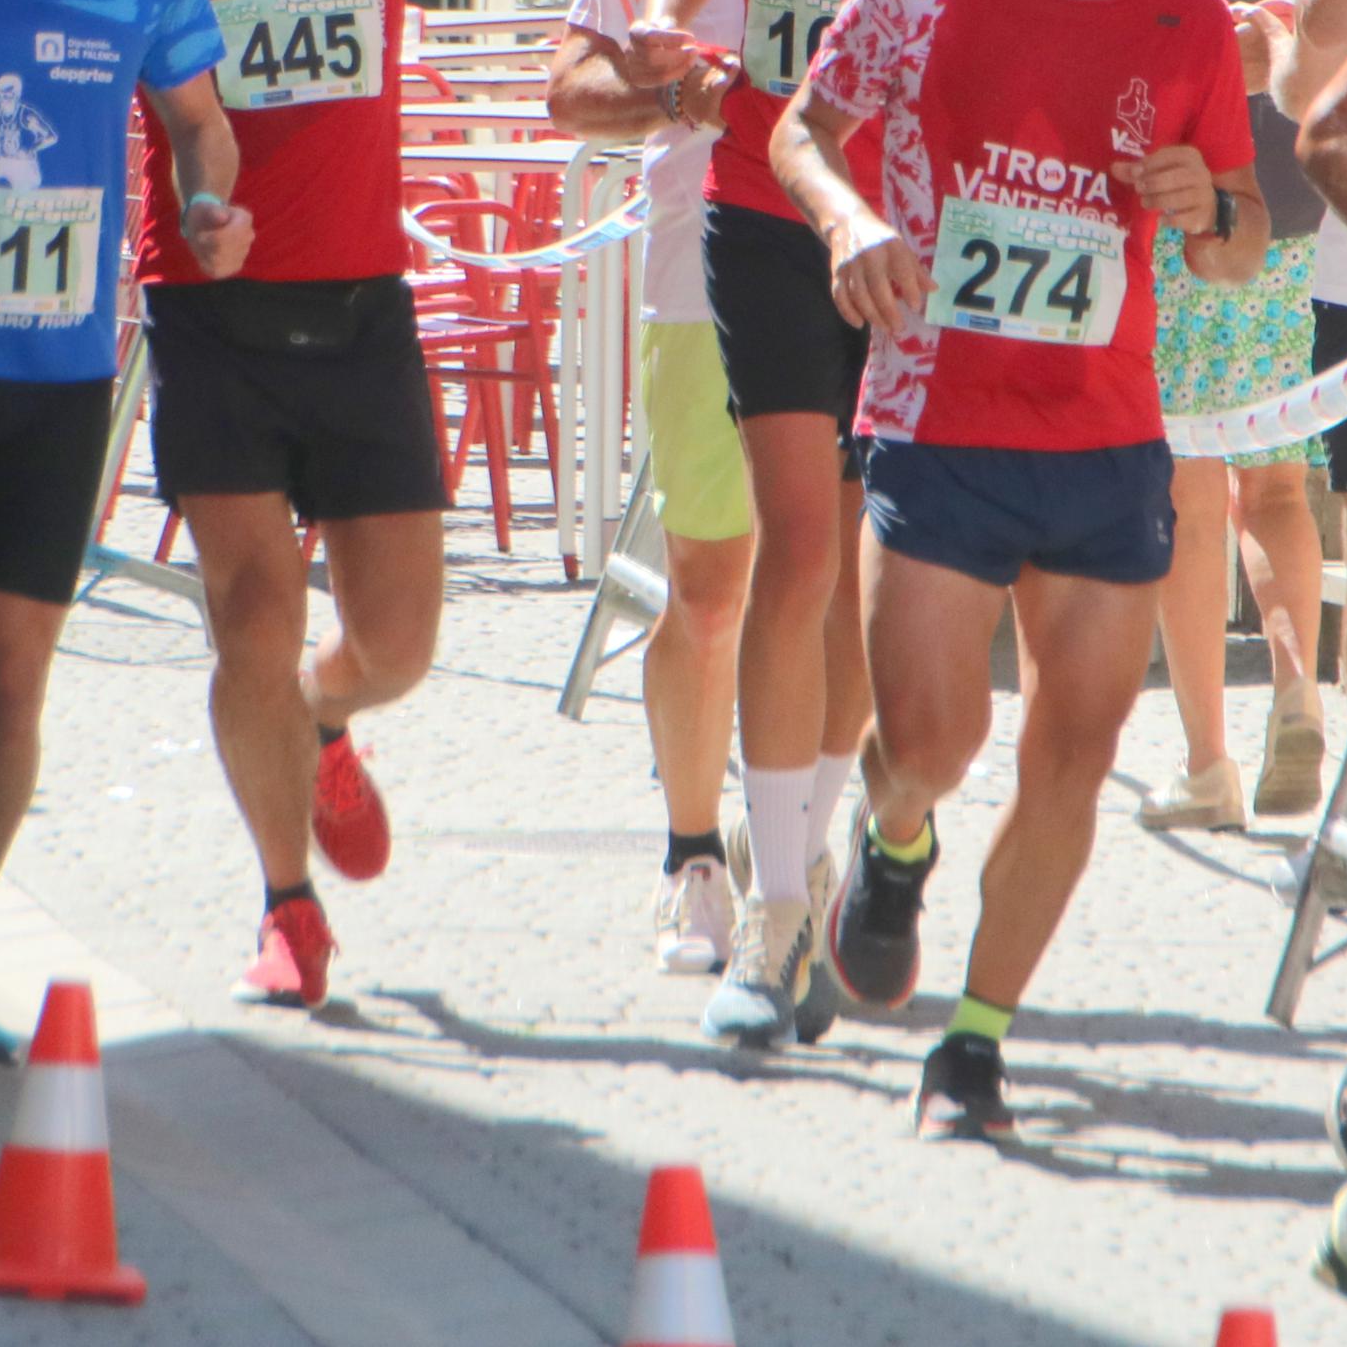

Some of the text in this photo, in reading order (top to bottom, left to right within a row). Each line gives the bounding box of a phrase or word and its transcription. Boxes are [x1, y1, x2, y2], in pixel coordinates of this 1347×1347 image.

[240, 13, 362, 87] 445
[983, 141, 1112, 206] TROTA
[954, 238, 1092, 323] 274
